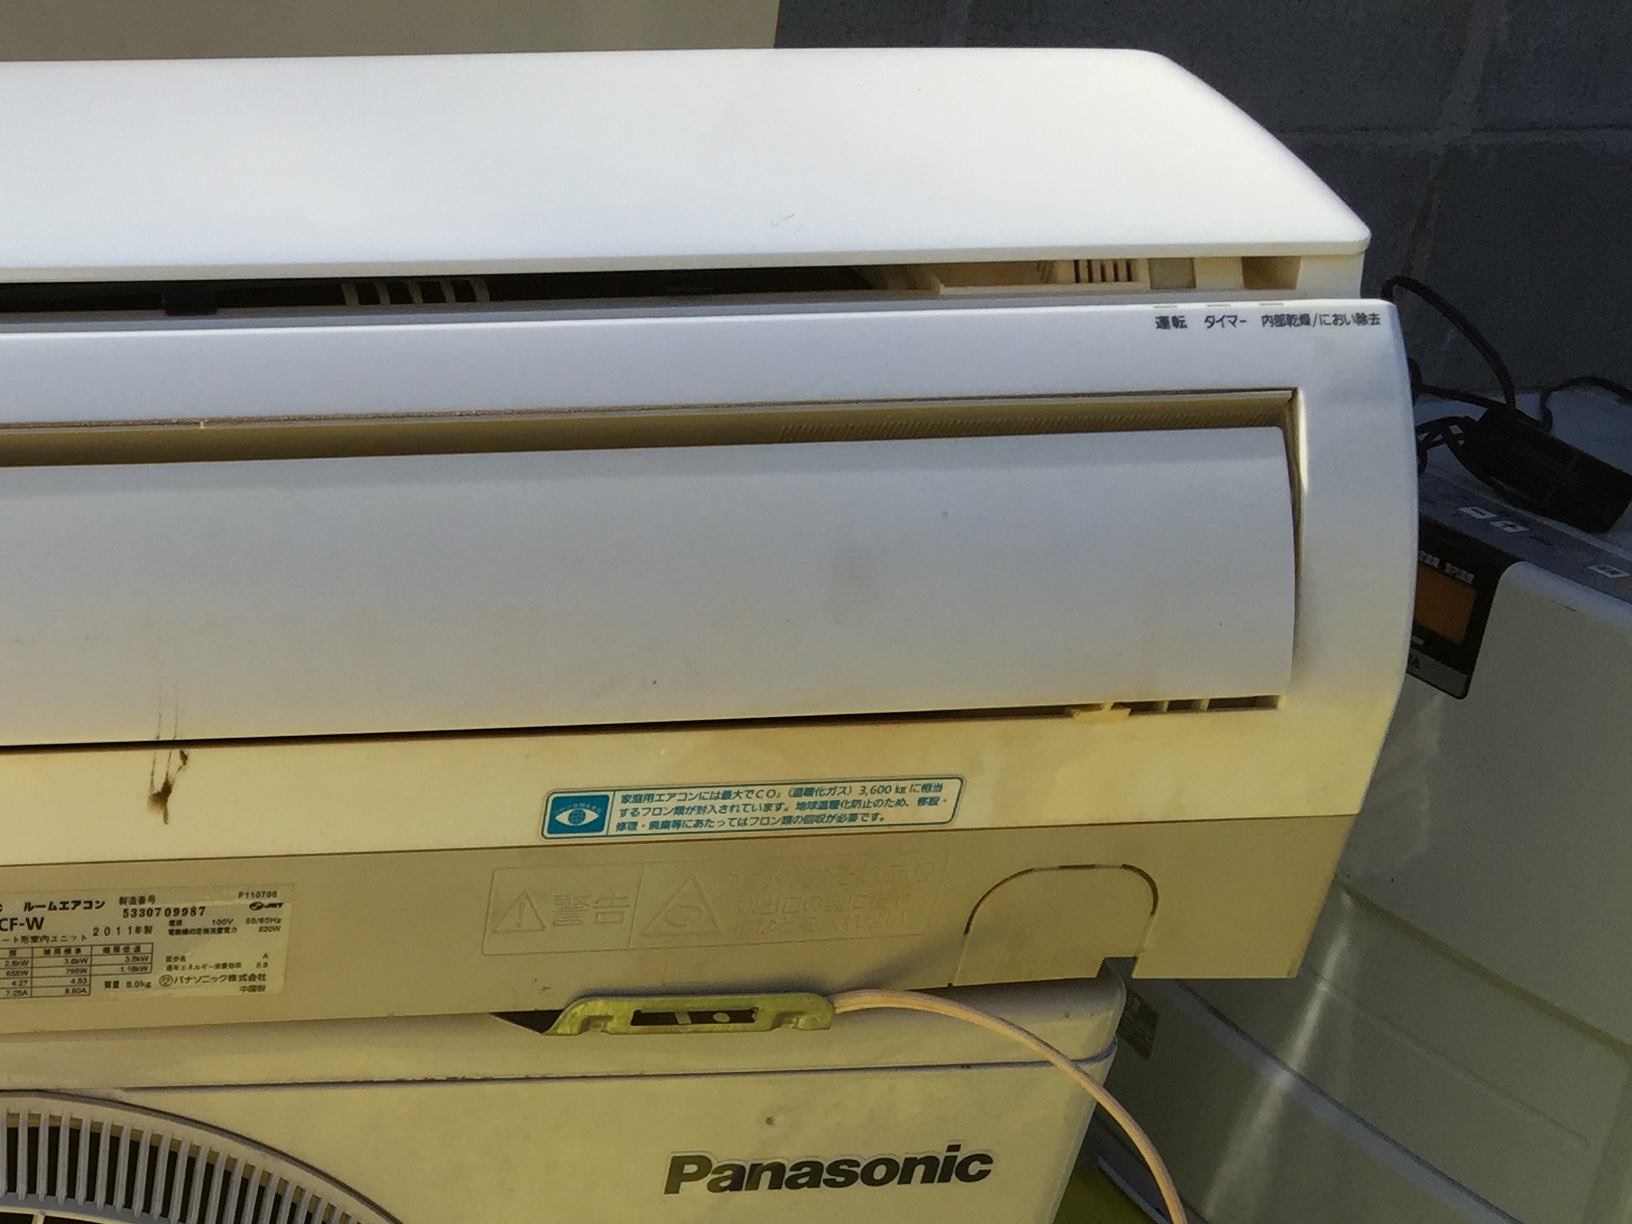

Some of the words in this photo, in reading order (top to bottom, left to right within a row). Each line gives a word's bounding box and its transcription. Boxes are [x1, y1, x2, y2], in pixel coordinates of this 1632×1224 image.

[1155, 315, 1188, 330] 運転
[1204, 314, 1248, 329] タイマー
[23, 900, 106, 913] ルームエアコン
[122, 906, 206, 919] 5330709987
[552, 893, 630, 927] 警告
[211, 918, 235, 926] 100V
[92, 925, 154, 937] 2011年製
[173, 973, 267, 985] パナソニック株式会社
[663, 1144, 994, 1195] Panasonic
